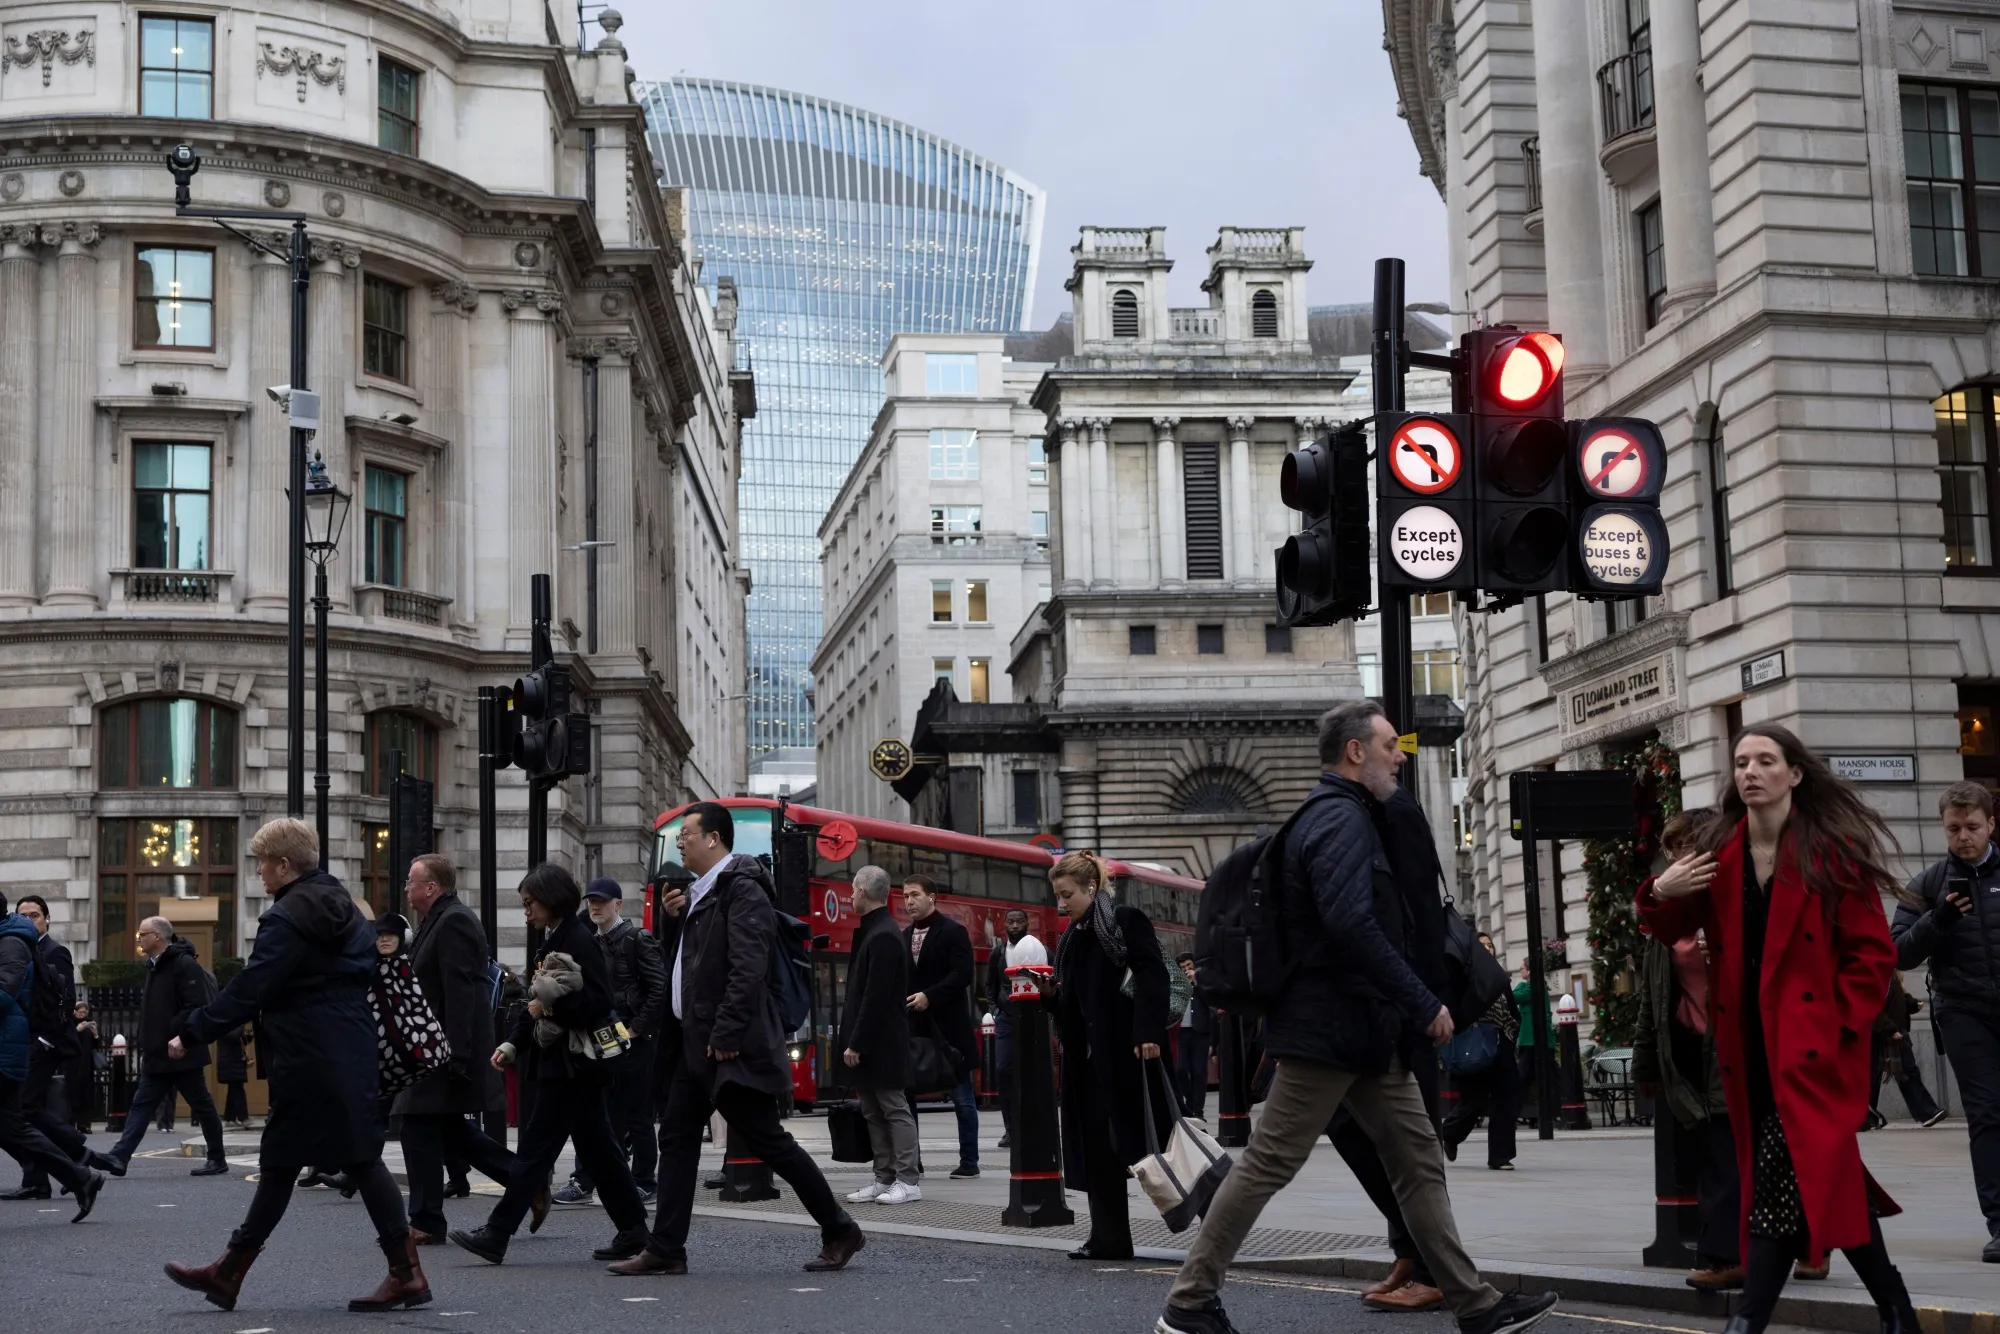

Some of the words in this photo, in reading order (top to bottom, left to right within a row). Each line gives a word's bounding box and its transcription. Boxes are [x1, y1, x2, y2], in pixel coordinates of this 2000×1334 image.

[1398, 526, 1457, 545] Except
[1588, 527, 1643, 545] Except
[1400, 546, 1455, 563] cycles
[1584, 544, 1631, 560] buses
[1636, 547, 1647, 561] &
[1590, 563, 1641, 579] cycles
[1586, 680, 1626, 706] LOMBARD
[1628, 666, 1658, 691] STREET
[1837, 760, 1877, 768] MANSION
[1879, 760, 1907, 768] HOUSE
[1839, 769, 1863, 778] PLACE
